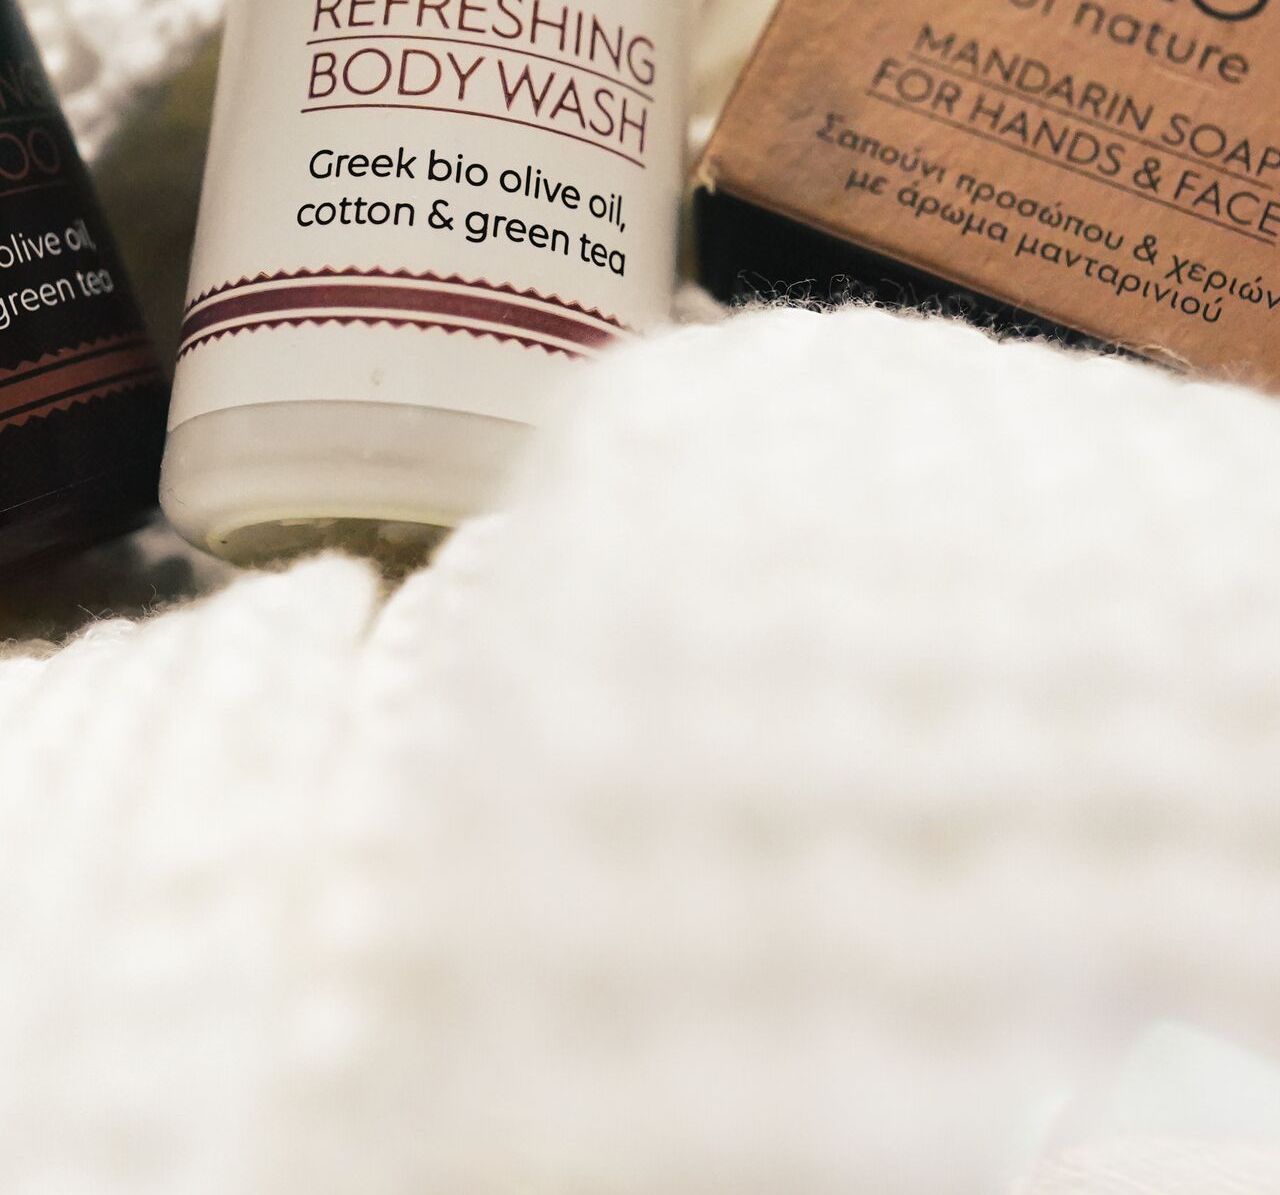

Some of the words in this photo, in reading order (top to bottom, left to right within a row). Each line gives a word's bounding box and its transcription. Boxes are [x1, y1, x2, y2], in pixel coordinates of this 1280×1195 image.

[914, 22, 1154, 134] MANDARIN
[1071, 0, 1251, 86] nature
[307, 47, 486, 101] BODY
[497, 58, 649, 155] WASH
[870, 56, 962, 114] FOR
[970, 91, 1122, 179] HANDS
[1132, 156, 1164, 194] &
[296, 197, 415, 228] cotton
[427, 199, 455, 231] &
[465, 210, 570, 256] green
[579, 232, 626, 277] tea
[308, 147, 417, 180] Greek
[427, 149, 489, 188] bio
[499, 165, 581, 210] olive
[589, 188, 627, 233] oil,
[816, 111, 947, 185] Σαπούνι
[955, 172, 1124, 252] προσώπου
[1132, 234, 1158, 265] &
[75, 268, 115, 298] tea
[844, 165, 888, 197] με
[896, 177, 1009, 245] άρωμα
[1014, 232, 1223, 326] μανταρινιού
